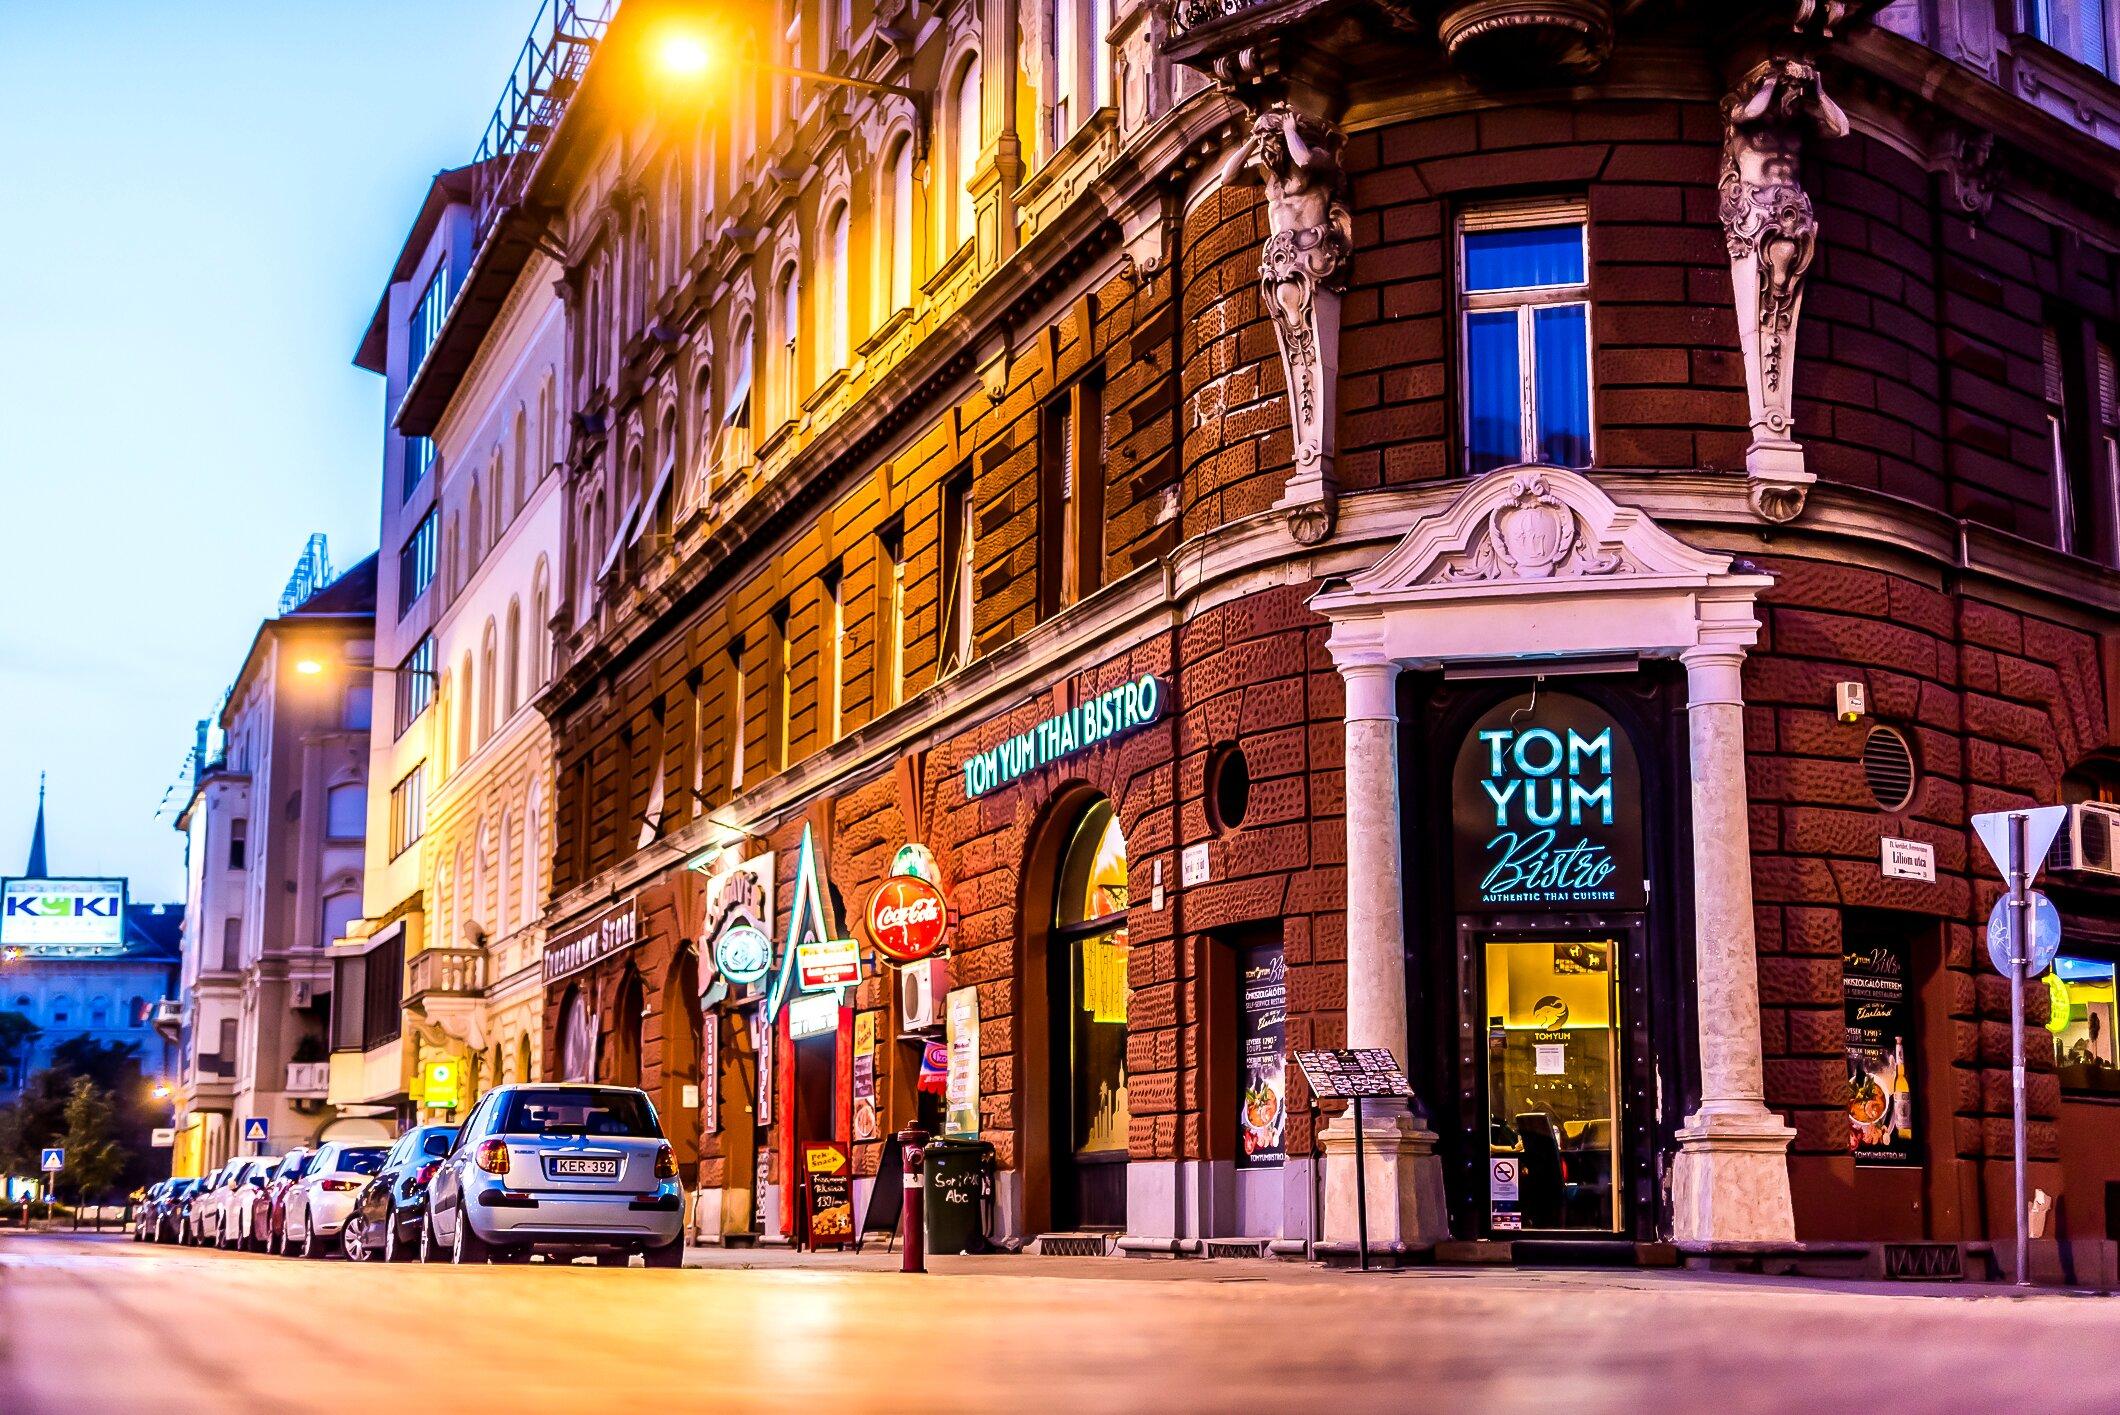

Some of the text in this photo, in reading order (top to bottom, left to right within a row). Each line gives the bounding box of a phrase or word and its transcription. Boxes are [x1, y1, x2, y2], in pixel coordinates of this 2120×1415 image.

[964, 673, 1157, 799] TOM YUM THAI BISTRO
[1479, 726, 1612, 777] TOM
[1480, 776, 1614, 827] YUM
[1479, 828, 1617, 894] Bistro
[1892, 851, 1927, 868] Liliom utca
[1482, 891, 1616, 902] AUTHENTIC THAI CUISINE
[876, 897, 938, 931] Coca-Cola
[559, 1160, 615, 1173] KER-392
[945, 1189, 969, 1204] Abc
